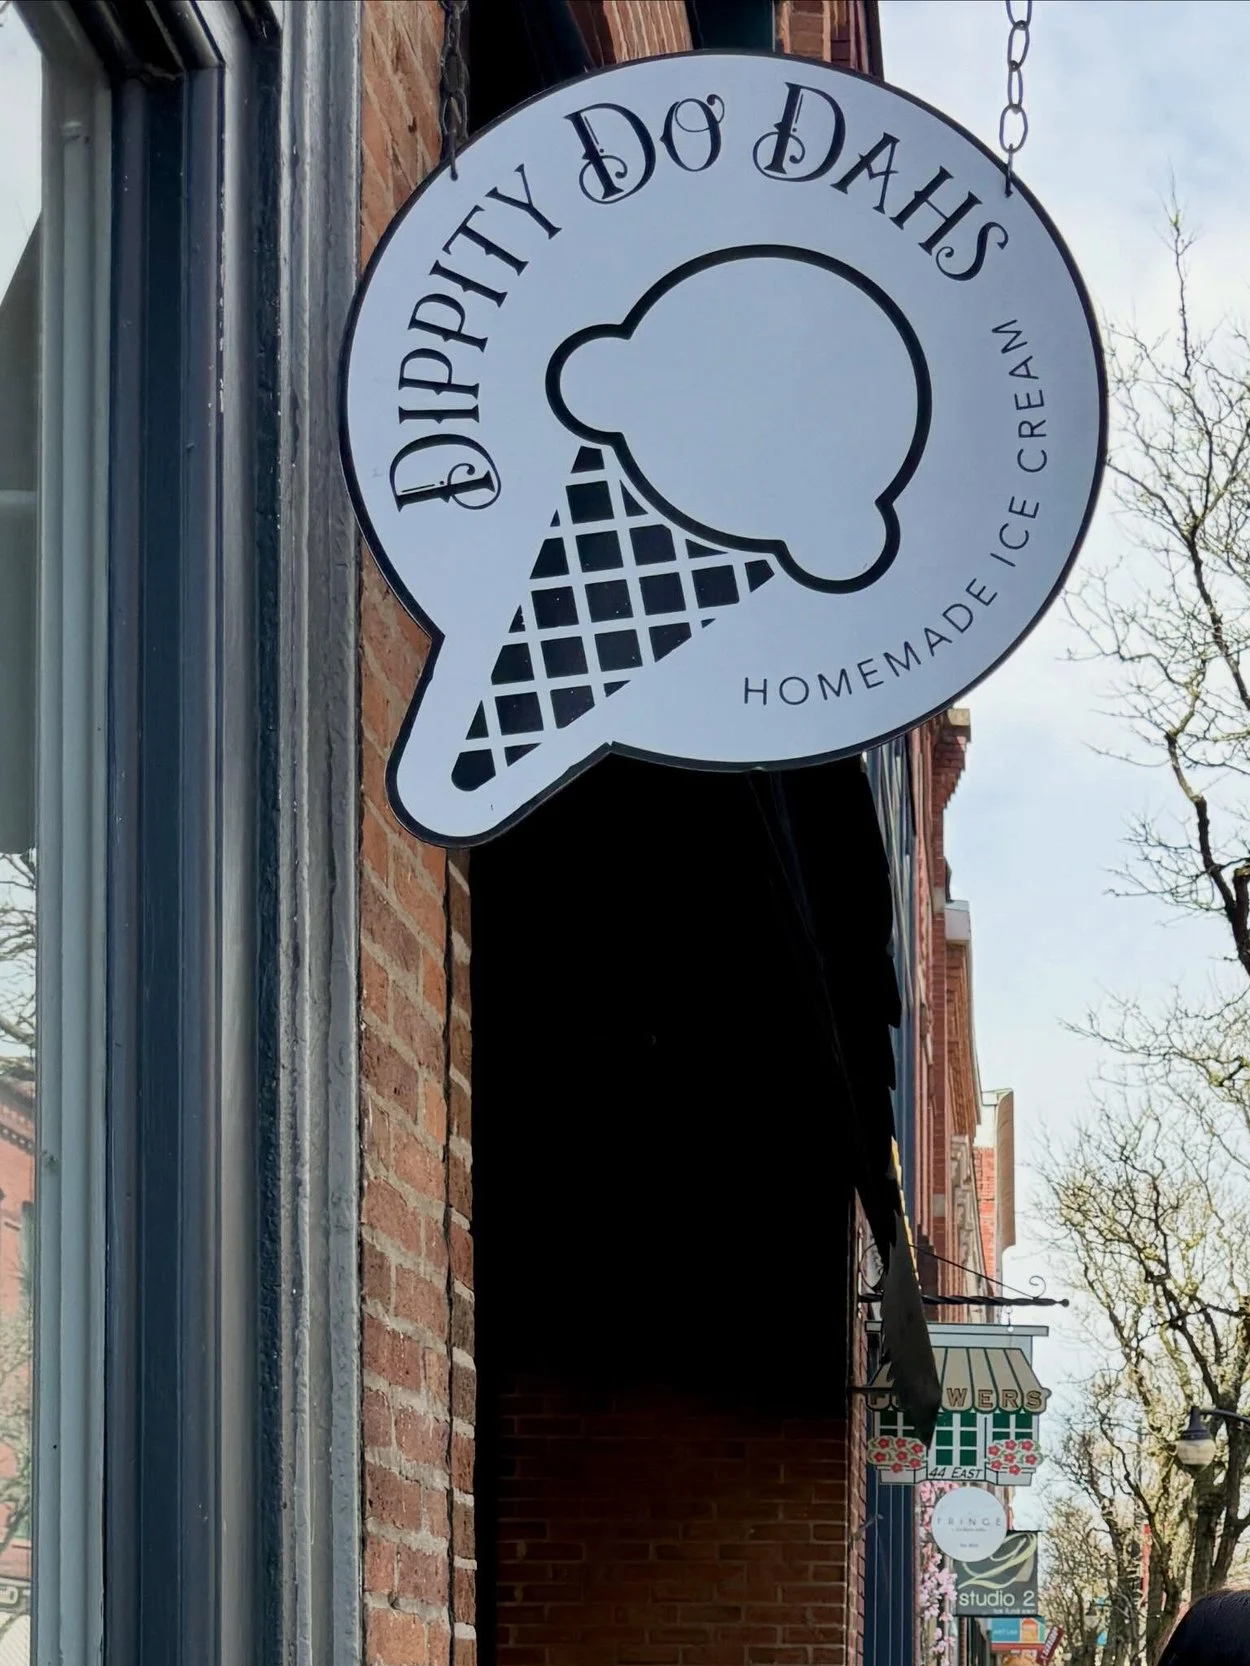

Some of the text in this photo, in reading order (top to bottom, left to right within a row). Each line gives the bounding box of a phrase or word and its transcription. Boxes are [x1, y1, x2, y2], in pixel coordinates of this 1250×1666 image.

[389, 82, 1008, 513] DIPPITY DO DAHS
[744, 319, 1048, 706] HOMEMADE ICE CREAM
[928, 1467, 983, 1479] 44 EAST
[937, 1517, 1002, 1527] FRINGE
[959, 1590, 1035, 1607] studio 2
